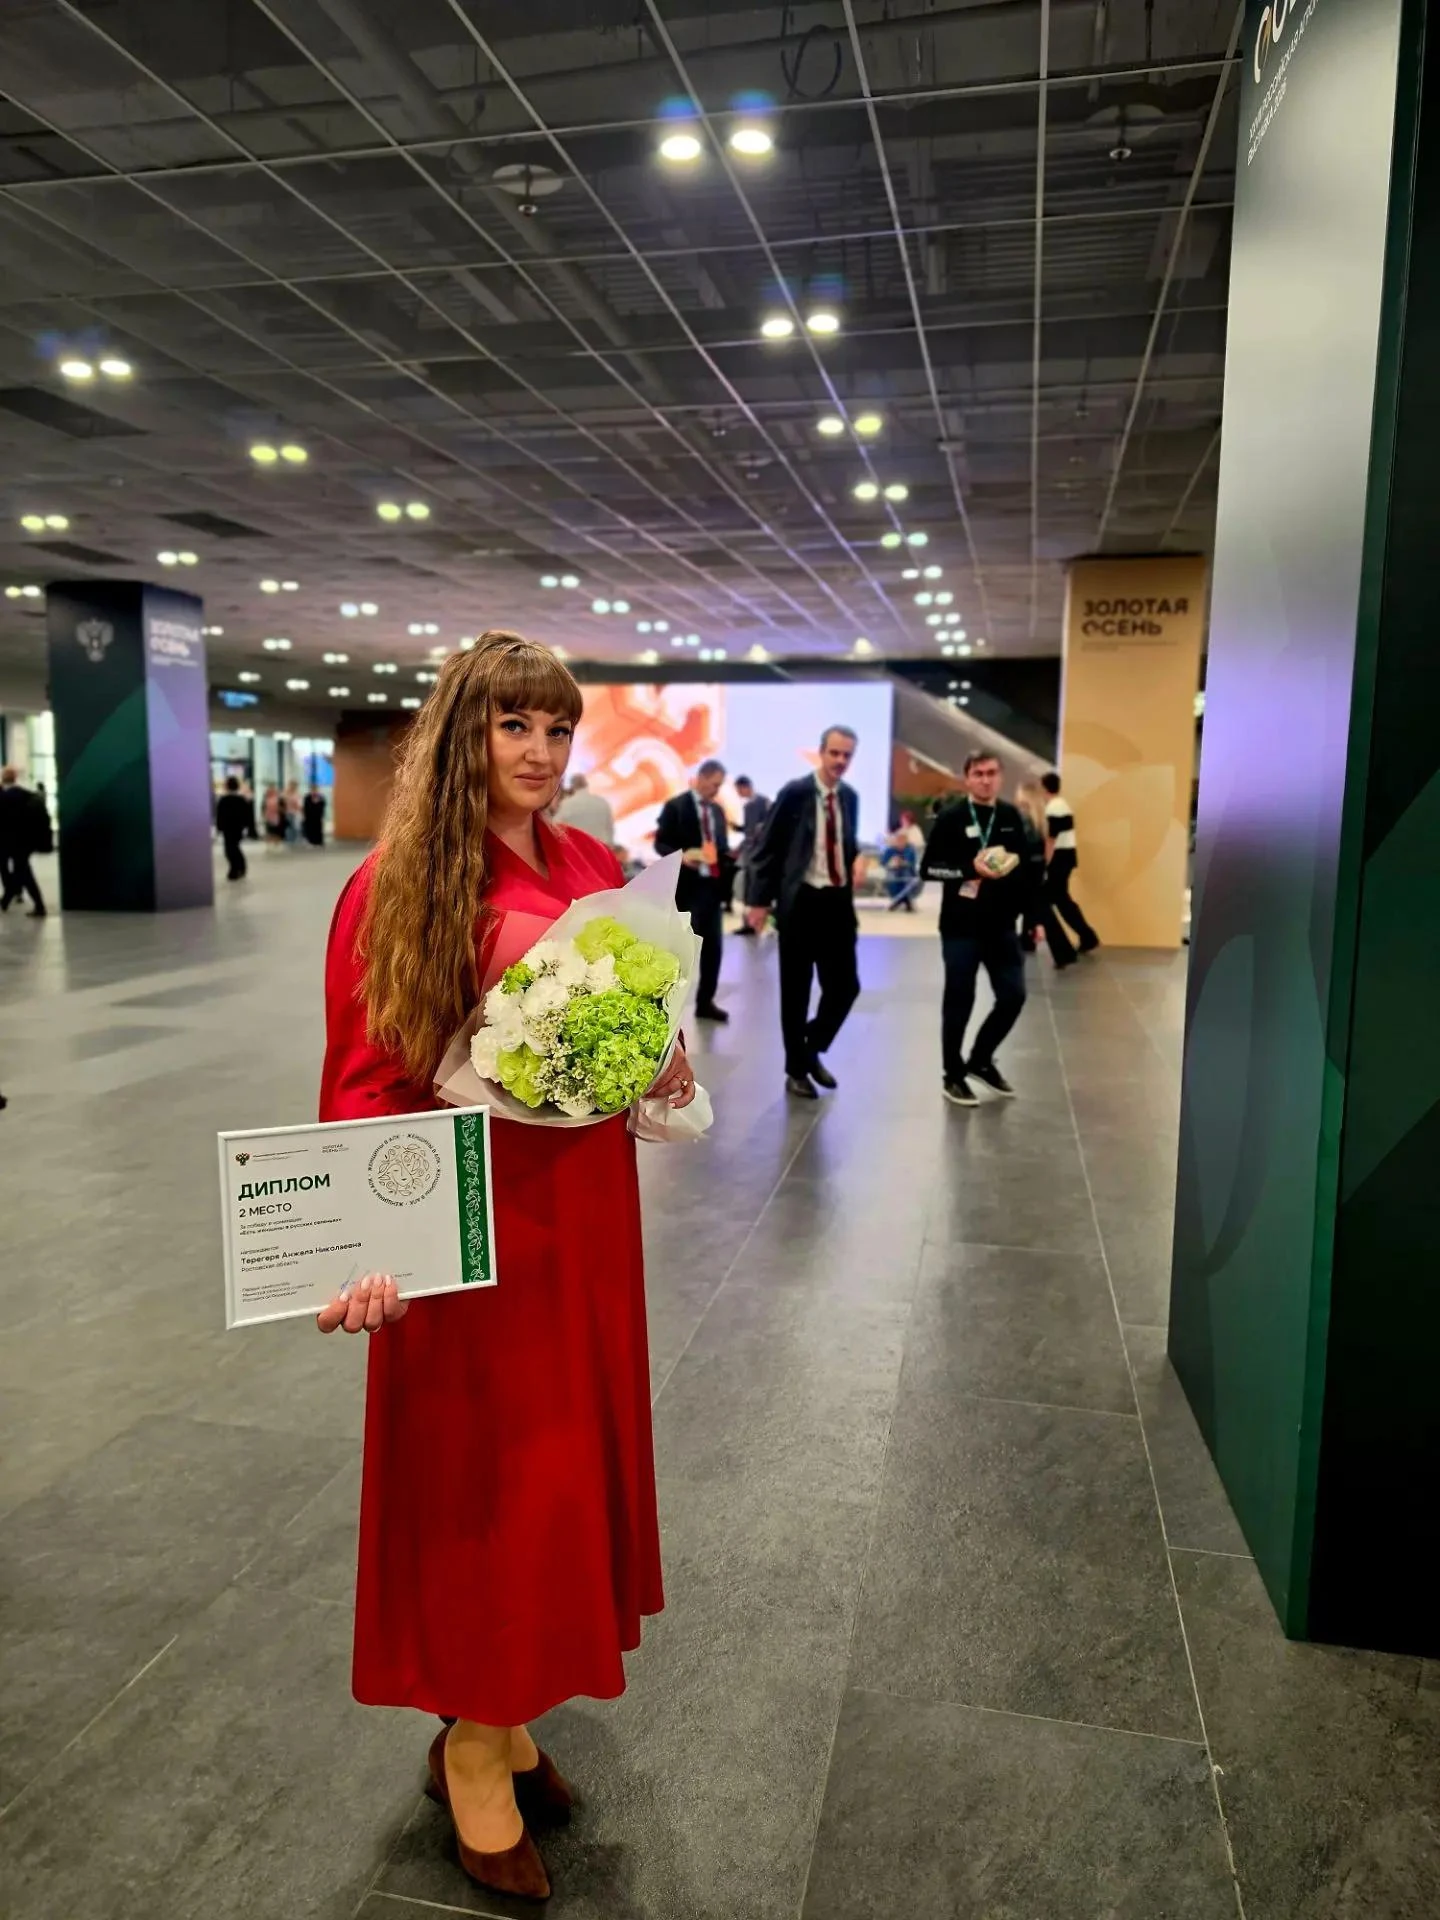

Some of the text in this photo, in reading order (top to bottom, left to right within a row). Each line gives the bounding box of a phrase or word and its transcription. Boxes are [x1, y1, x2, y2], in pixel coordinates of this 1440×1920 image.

[1083, 597, 1189, 617] ЗОЛОТАЯ
[1081, 618, 1163, 637] ОСЕНЬ
[237, 1173, 331, 1201] ДИПЛОМ
[239, 1202, 292, 1218] 2 МЕСТО
[290, 1221, 313, 1230] русских
[282, 1248, 314, 1259] Анжела
[315, 1241, 362, 1253] Николаевна
